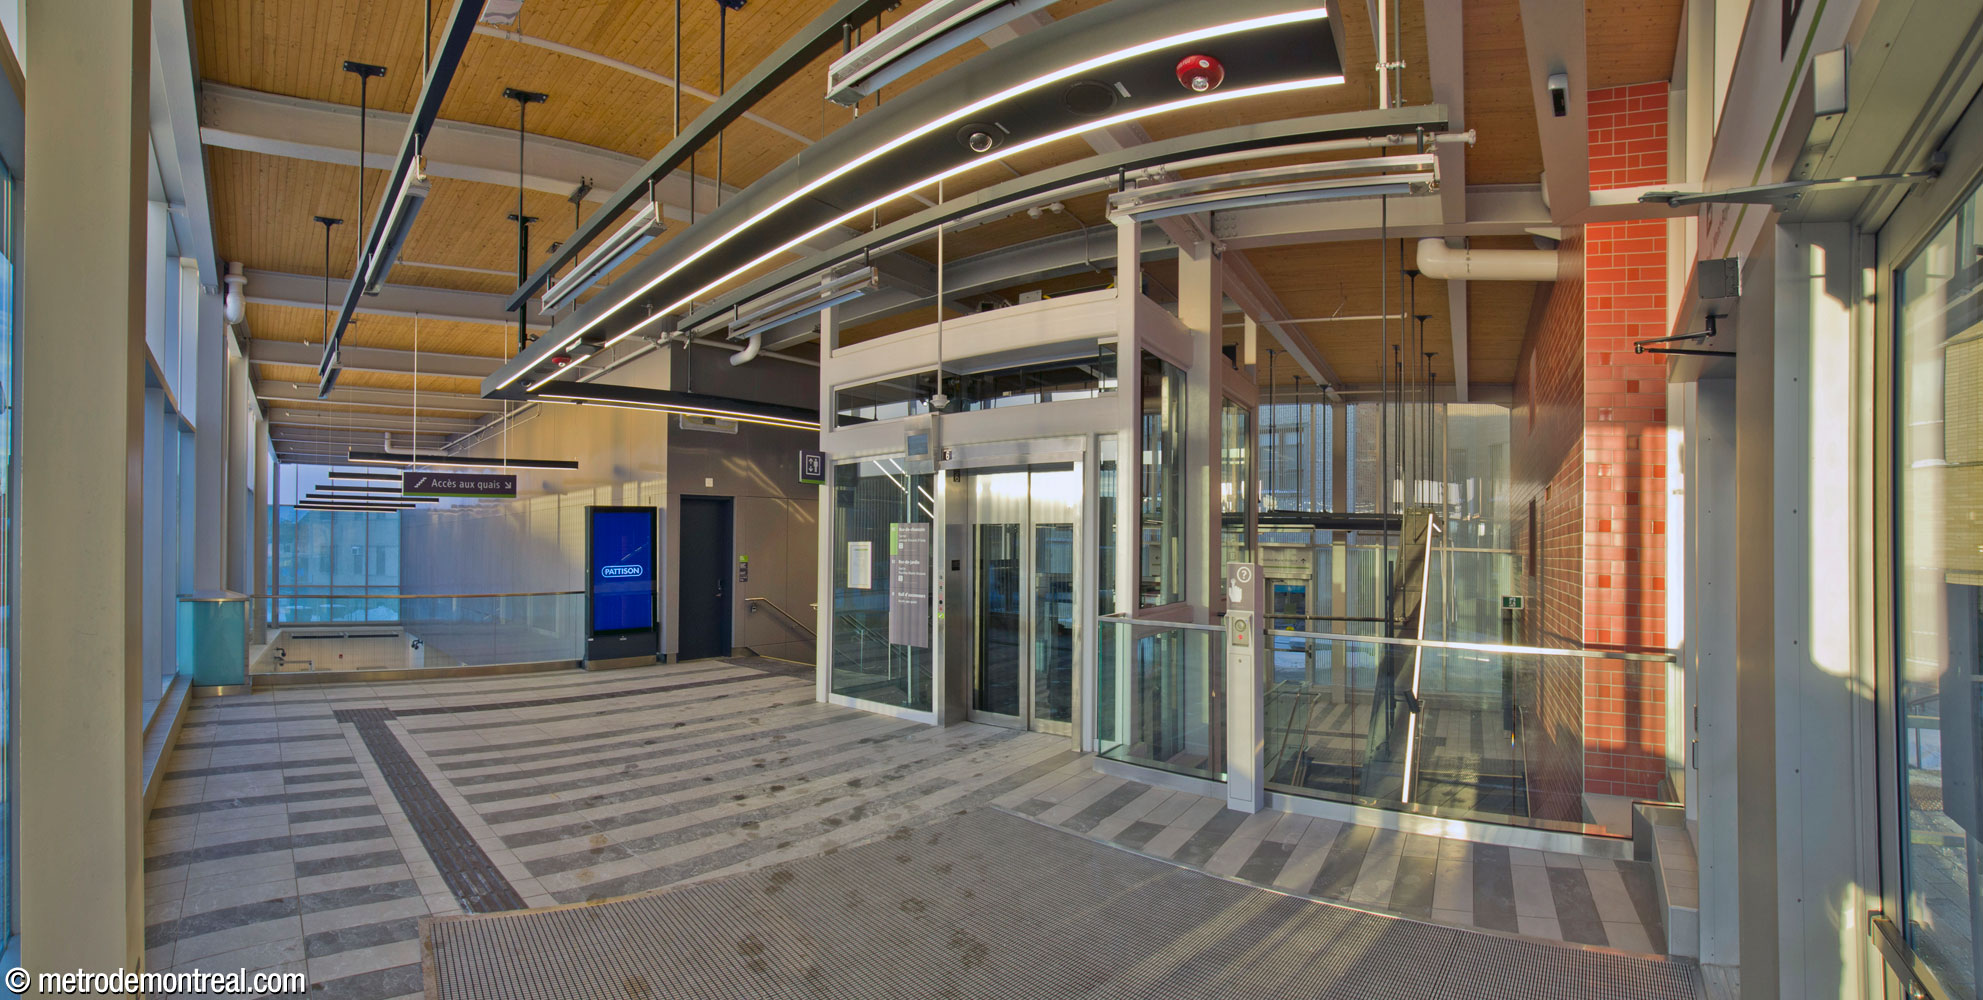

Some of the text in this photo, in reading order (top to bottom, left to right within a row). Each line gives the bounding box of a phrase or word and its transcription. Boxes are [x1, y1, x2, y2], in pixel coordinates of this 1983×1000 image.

[431, 478, 501, 491] Accès aux quais
[604, 567, 640, 576] PATTISON
